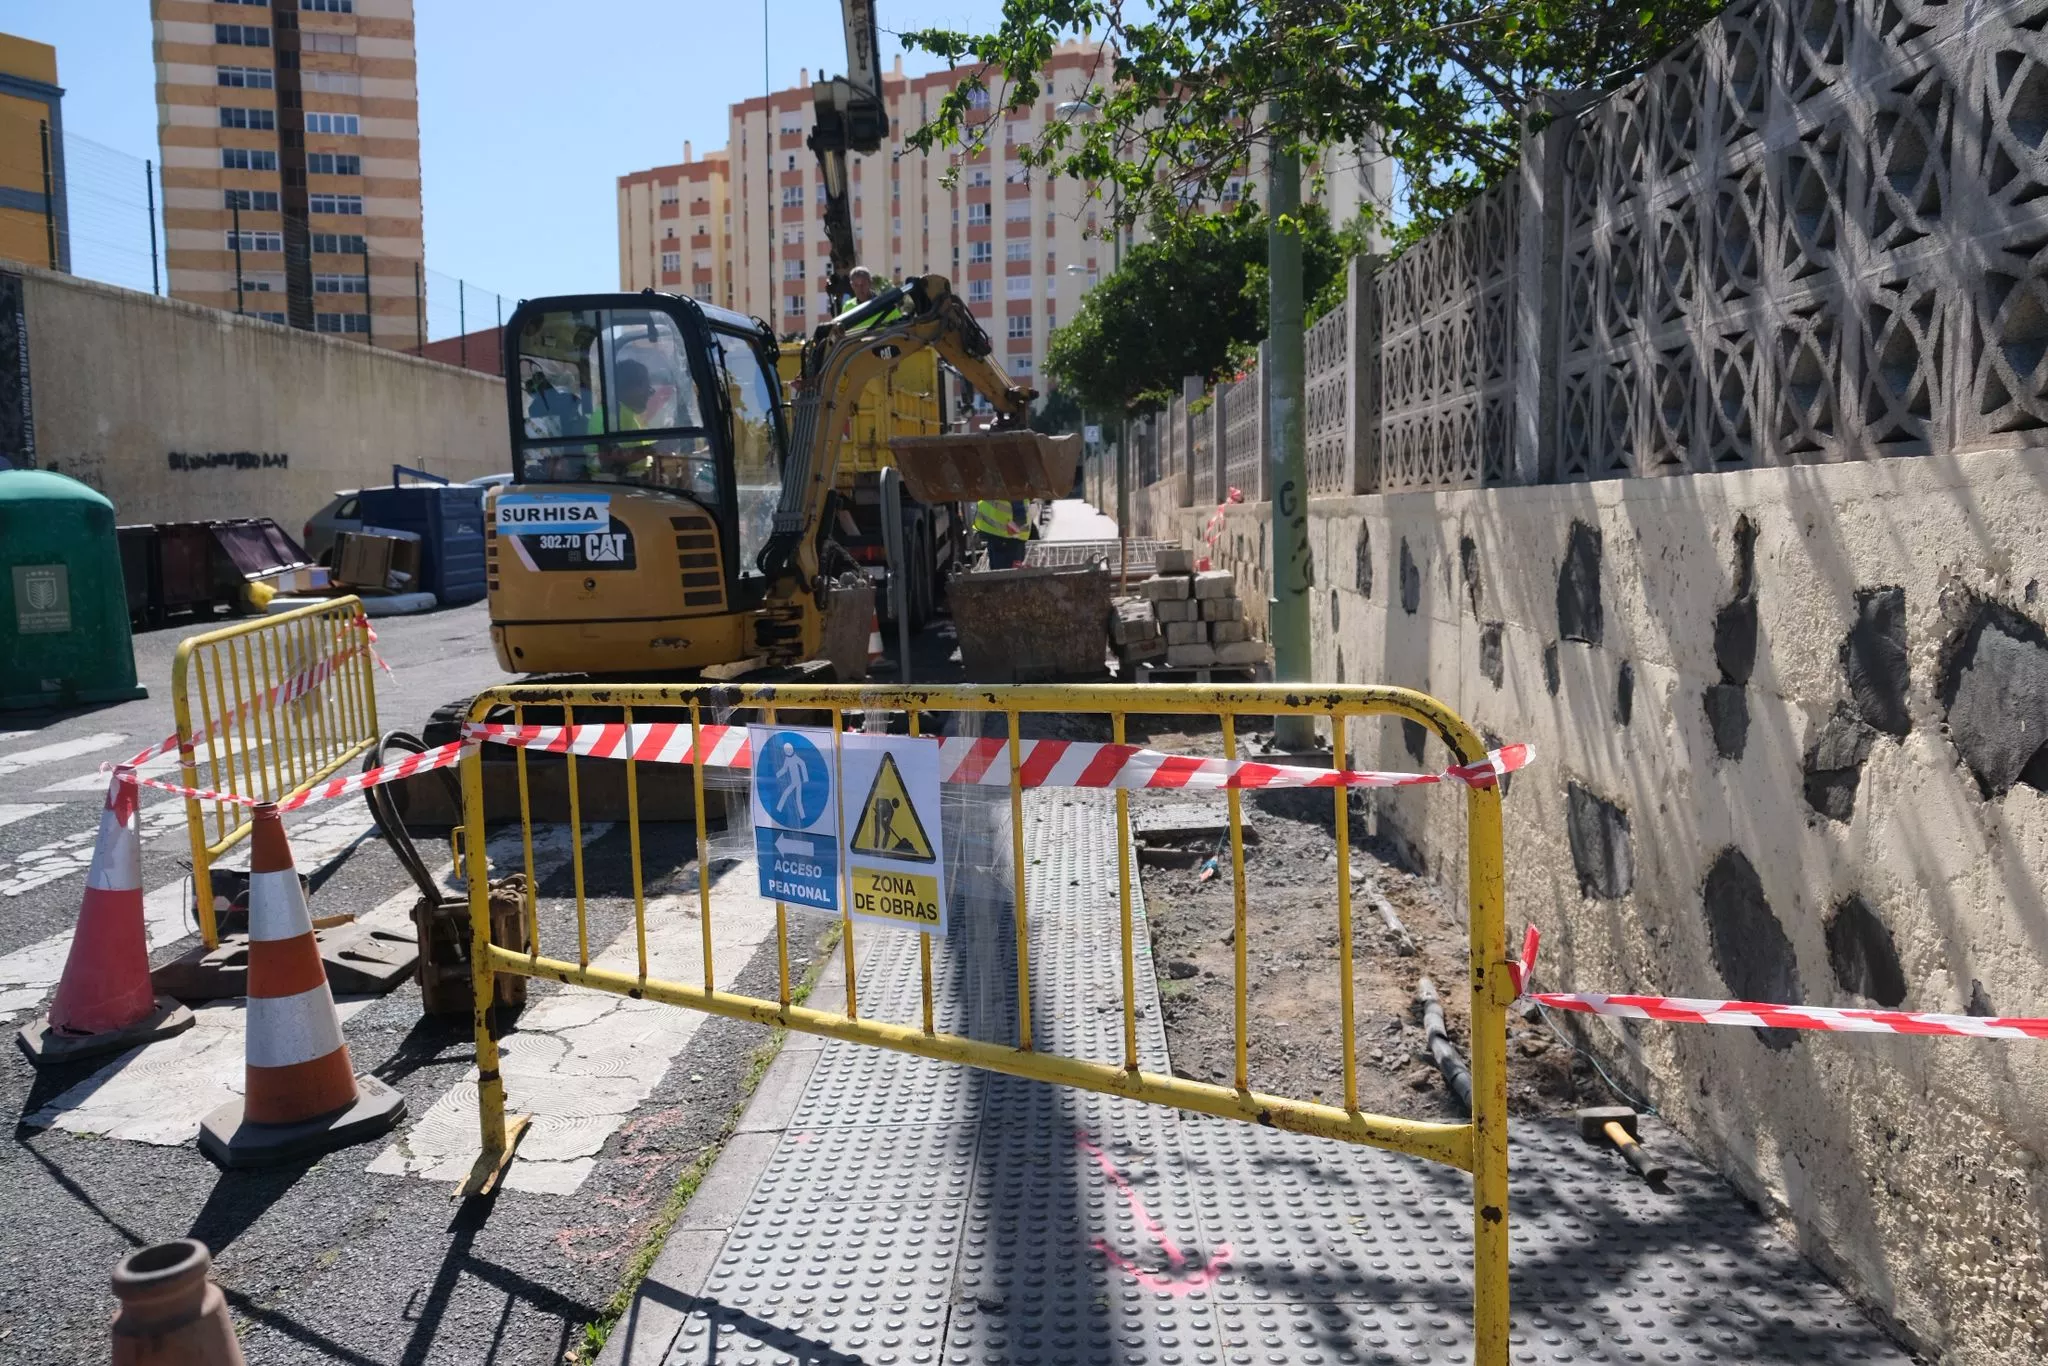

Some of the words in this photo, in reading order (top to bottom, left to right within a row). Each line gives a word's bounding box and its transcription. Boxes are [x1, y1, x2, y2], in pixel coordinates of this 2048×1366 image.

[502, 506, 599, 522] SURHISA
[539, 534, 581, 549] 302.7D
[585, 533, 627, 562] CAT
[774, 859, 822, 879] ACCESO
[768, 879, 831, 902] PEATONAL
[871, 874, 916, 897] ZONA
[854, 892, 875, 911] DE
[880, 896, 938, 921] OBRAS
